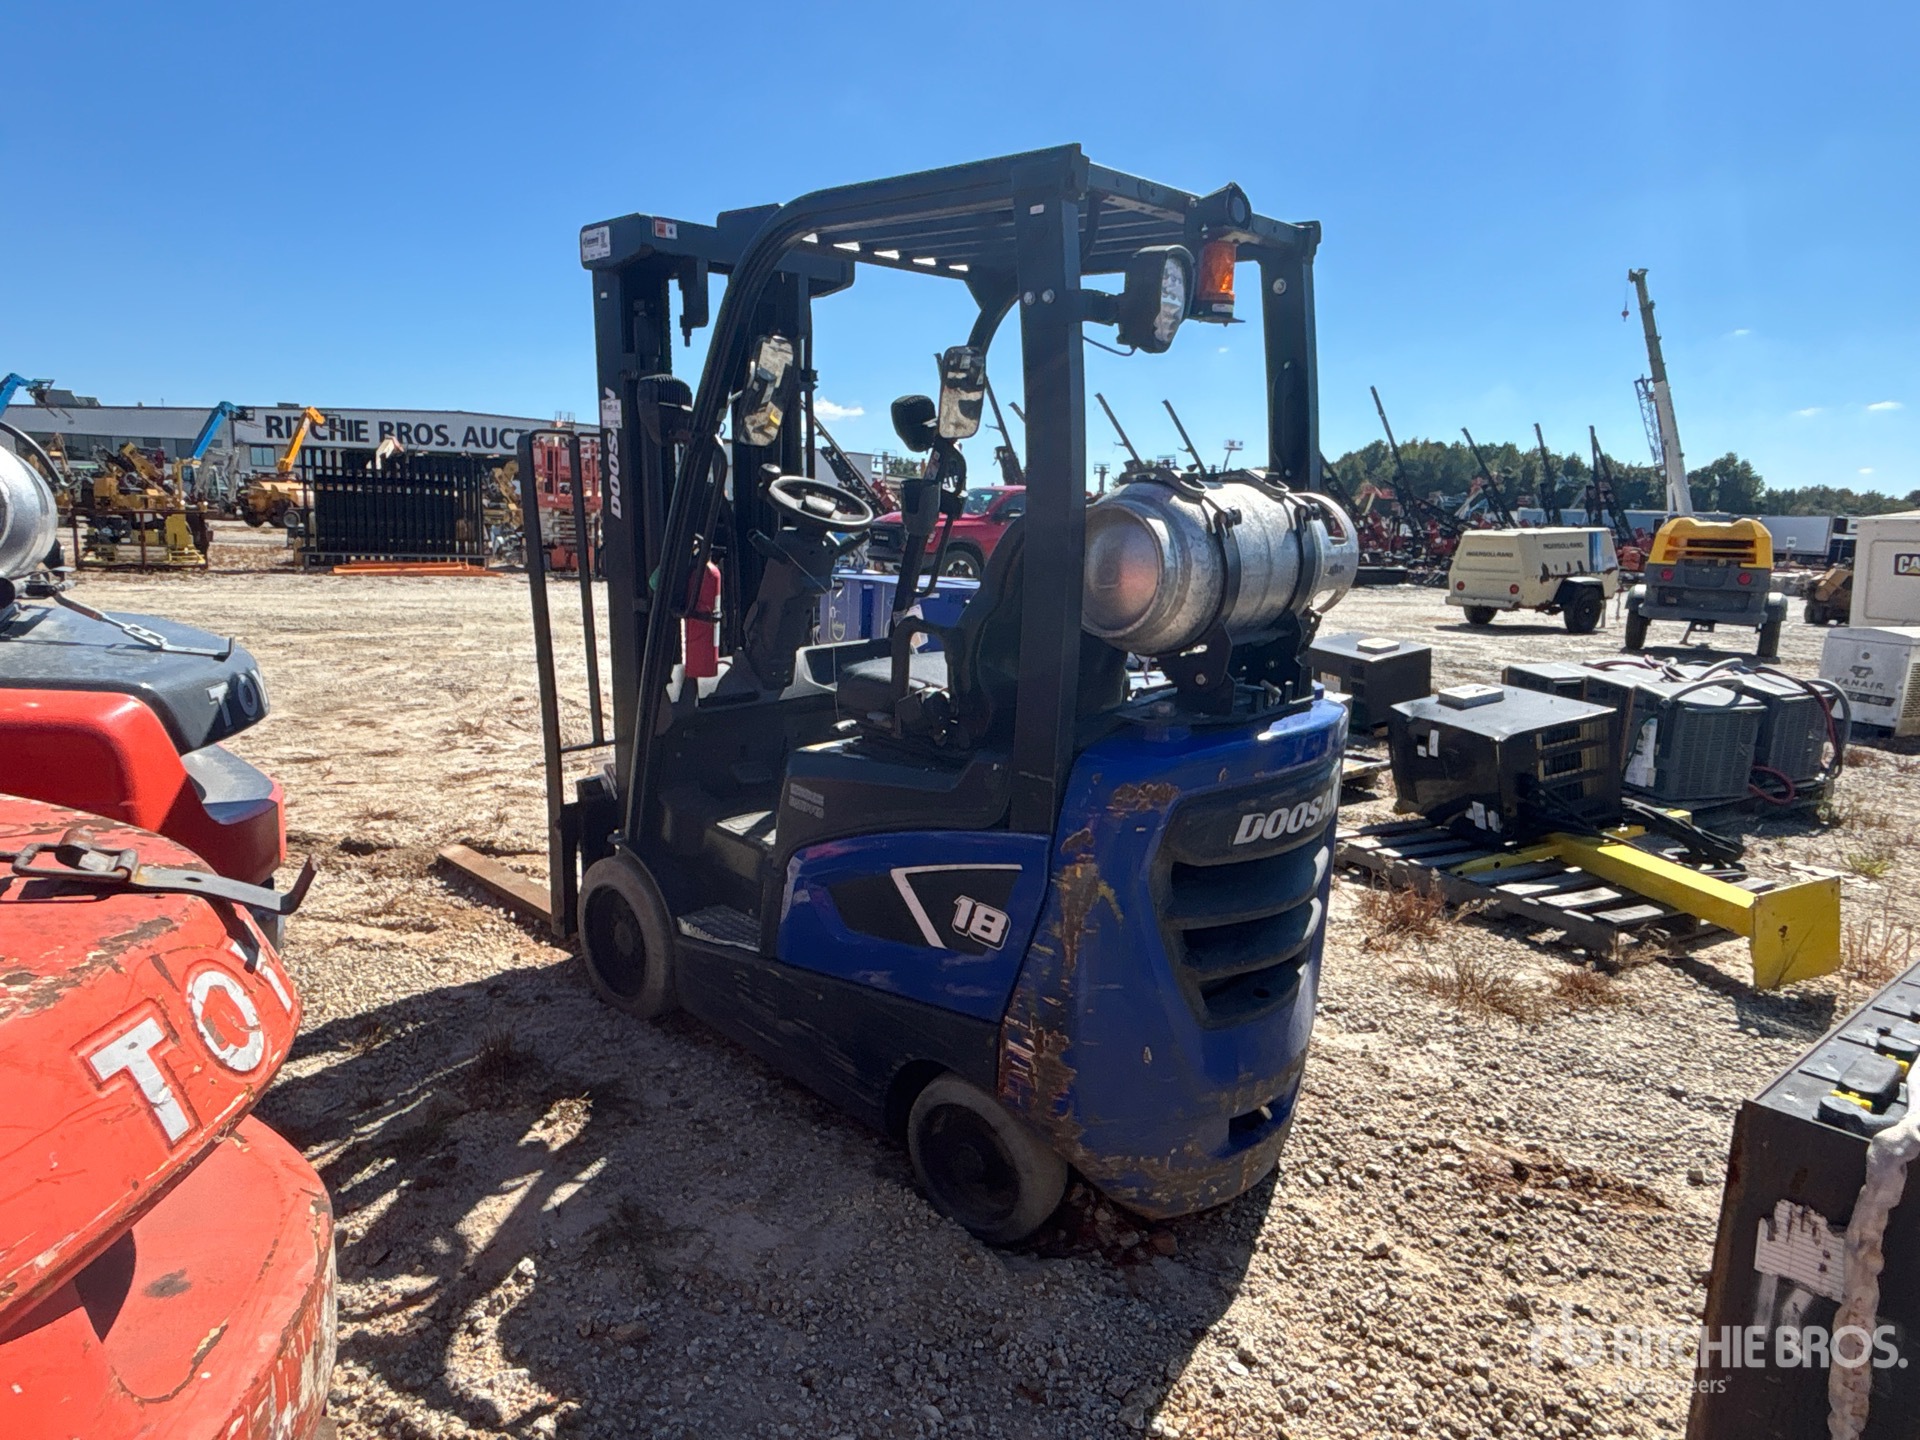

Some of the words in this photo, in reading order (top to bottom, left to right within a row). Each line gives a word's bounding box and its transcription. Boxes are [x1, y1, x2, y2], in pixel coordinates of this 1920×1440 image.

[265, 414, 370, 443] RICHIE
[378, 421, 456, 447] BROS.
[1834, 677, 1884, 690] VANAIR
[952, 895, 1011, 951] 18
